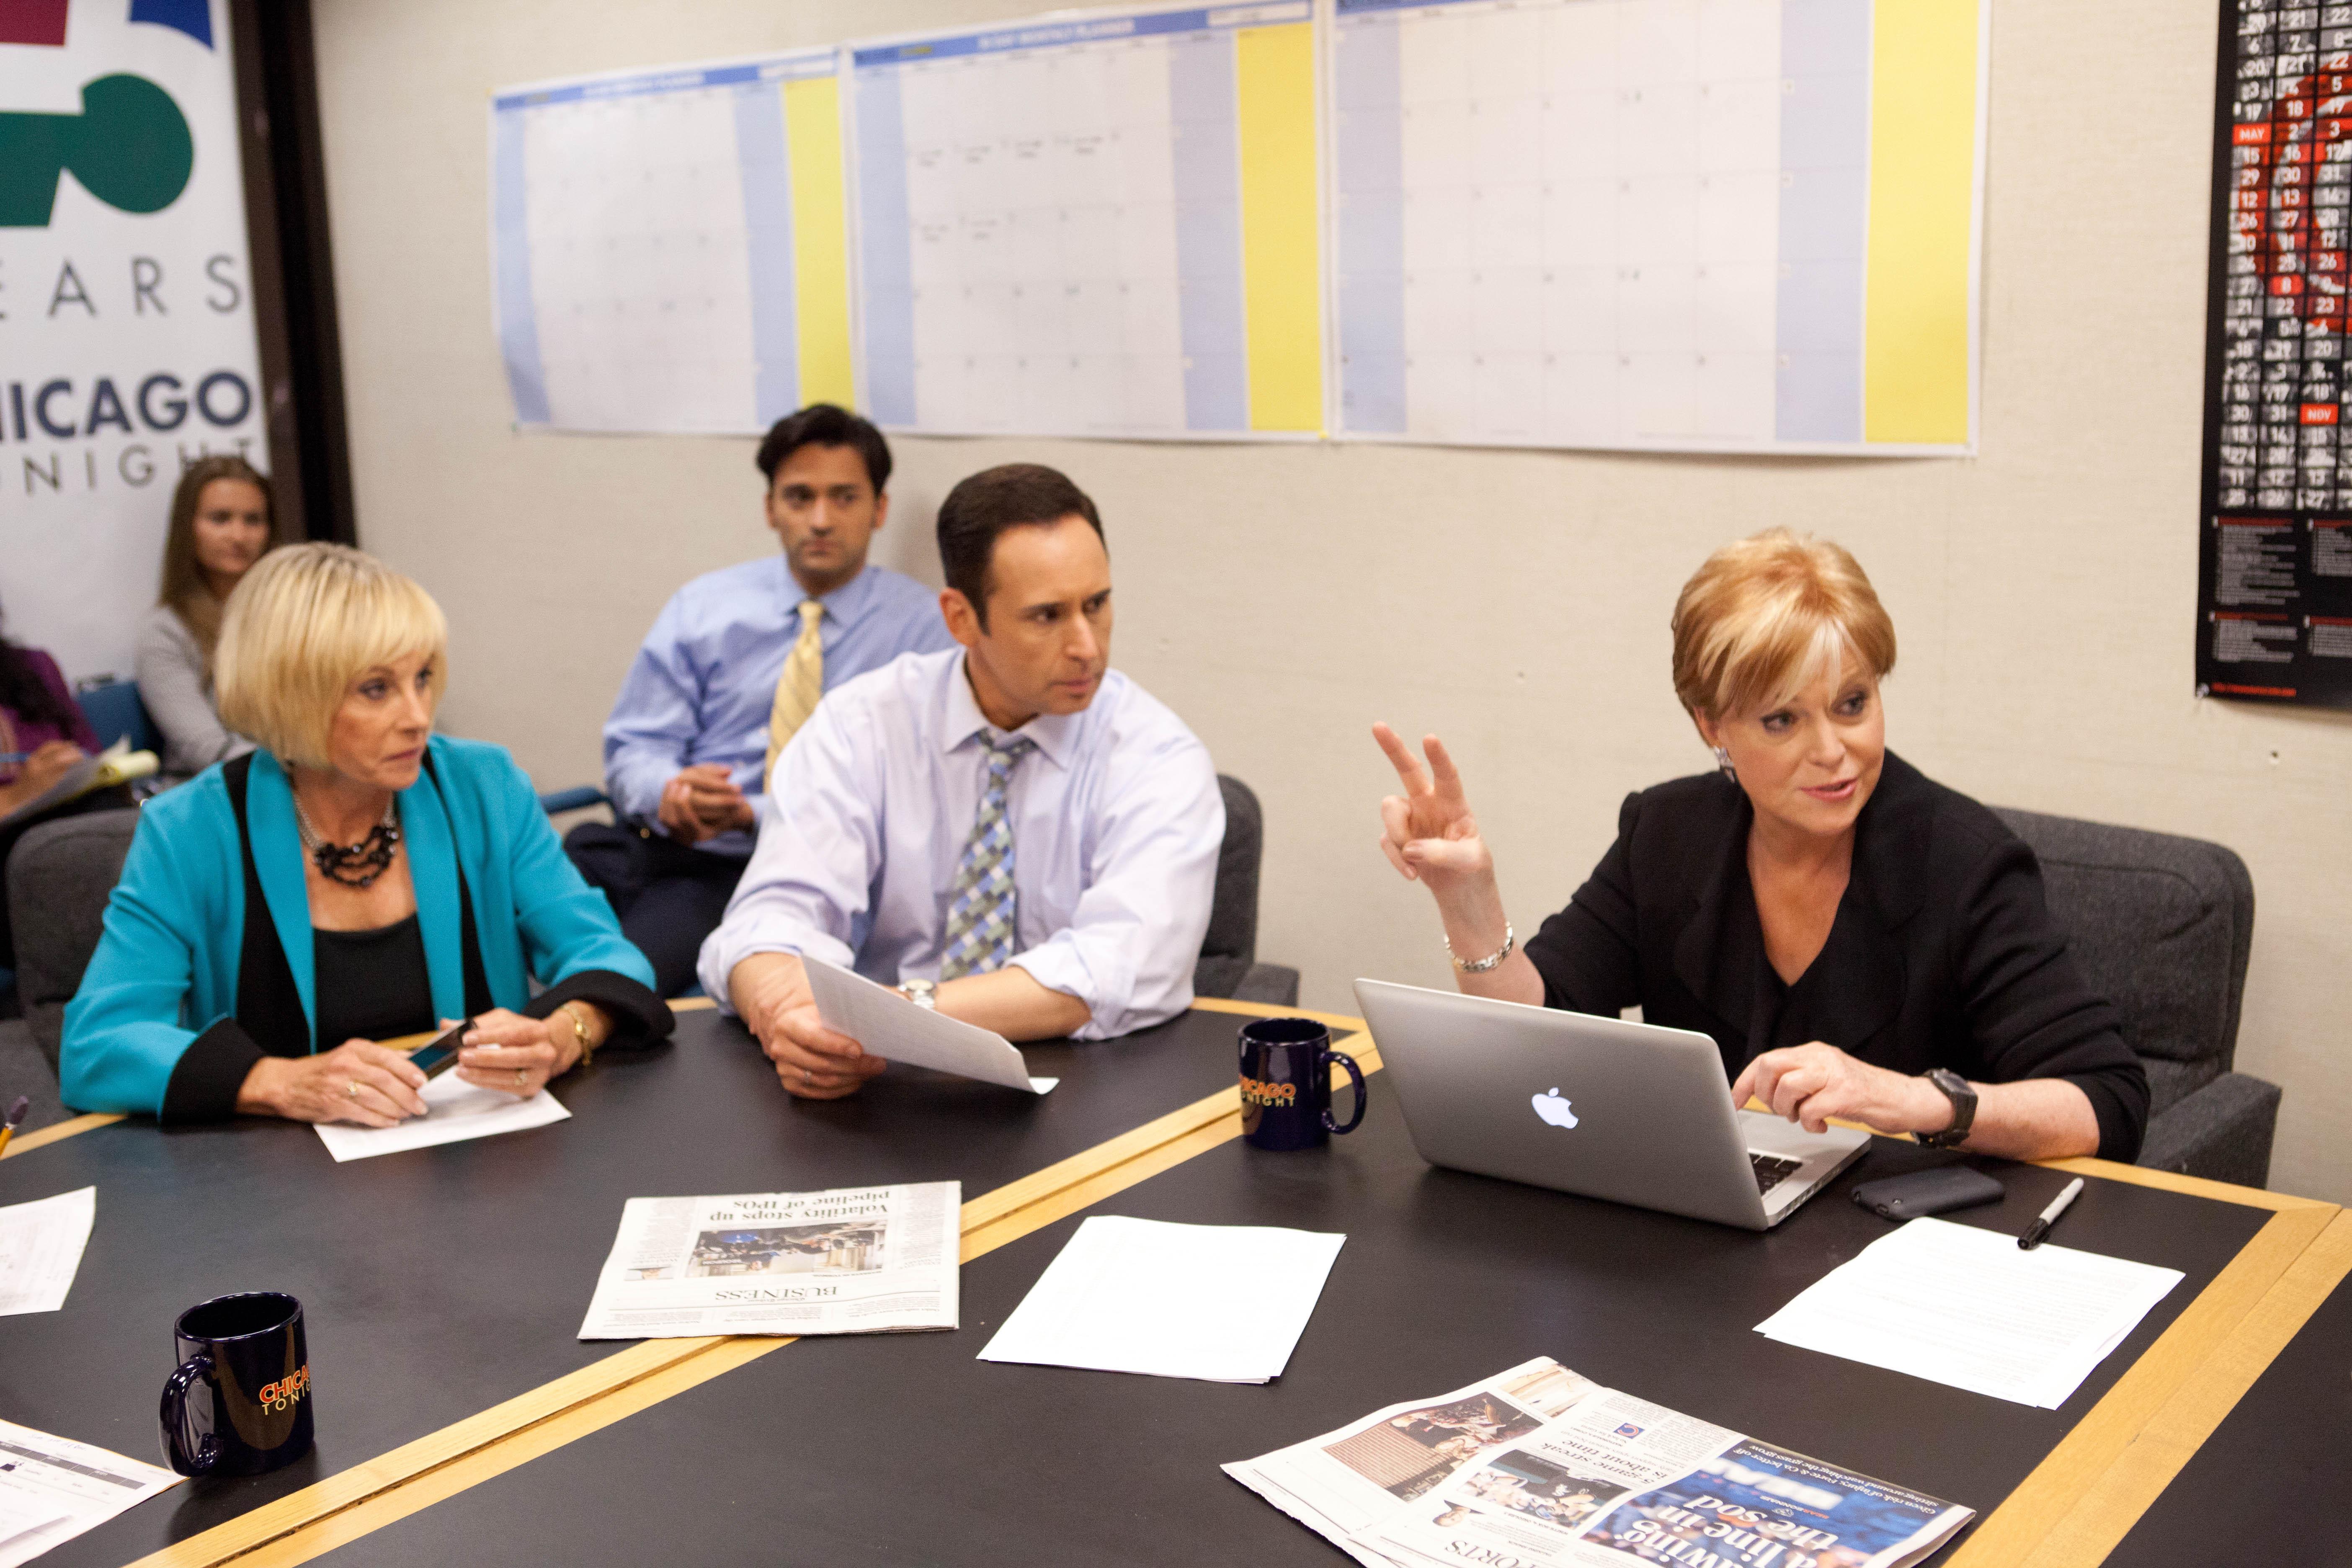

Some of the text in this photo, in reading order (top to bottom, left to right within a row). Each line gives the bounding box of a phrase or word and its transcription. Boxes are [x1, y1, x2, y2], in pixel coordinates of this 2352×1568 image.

[2331, 7, 2350, 24] 22
[2334, 32, 2345, 47] 8
[2331, 76, 2342, 92] 5
[2288, 101, 2303, 117] 18
[2241, 121, 2340, 140] MAY 2 3
[2244, 144, 2343, 164] 15 16 17
[2241, 169, 2260, 186] 29
[2282, 167, 2301, 183] 30
[2241, 191, 2258, 208] 12
[2283, 189, 2300, 205] 13
[2281, 210, 2299, 228] 27
[2322, 230, 2337, 250] 12
[2318, 253, 2337, 271] 26
[0, 253, 242, 320] ARS
[2282, 277, 2291, 294] 8
[2276, 297, 2294, 315] 22
[2316, 297, 2335, 314] 23
[0, 369, 254, 443] ICAGO
[2231, 405, 2331, 421] 30 31 NOV
[2231, 469, 2244, 485] 11
[733, 1191, 890, 1210] pipeline of IPOs
[709, 1204, 888, 1223] Volatility stops up
[715, 1286, 838, 1301] BUSINESS
[1542, 1443, 1591, 1462] streak
[1562, 1441, 1599, 1455] time
[1602, 1454, 1651, 1471] about
[1593, 1462, 1654, 1484] 5-game
[1905, 1501, 1936, 1514] Given
[1657, 1505, 1708, 1533] in
[1683, 1495, 1839, 1550] the sod
[1444, 1540, 1537, 1568] ORTS
[1703, 1521, 1788, 1568] line
